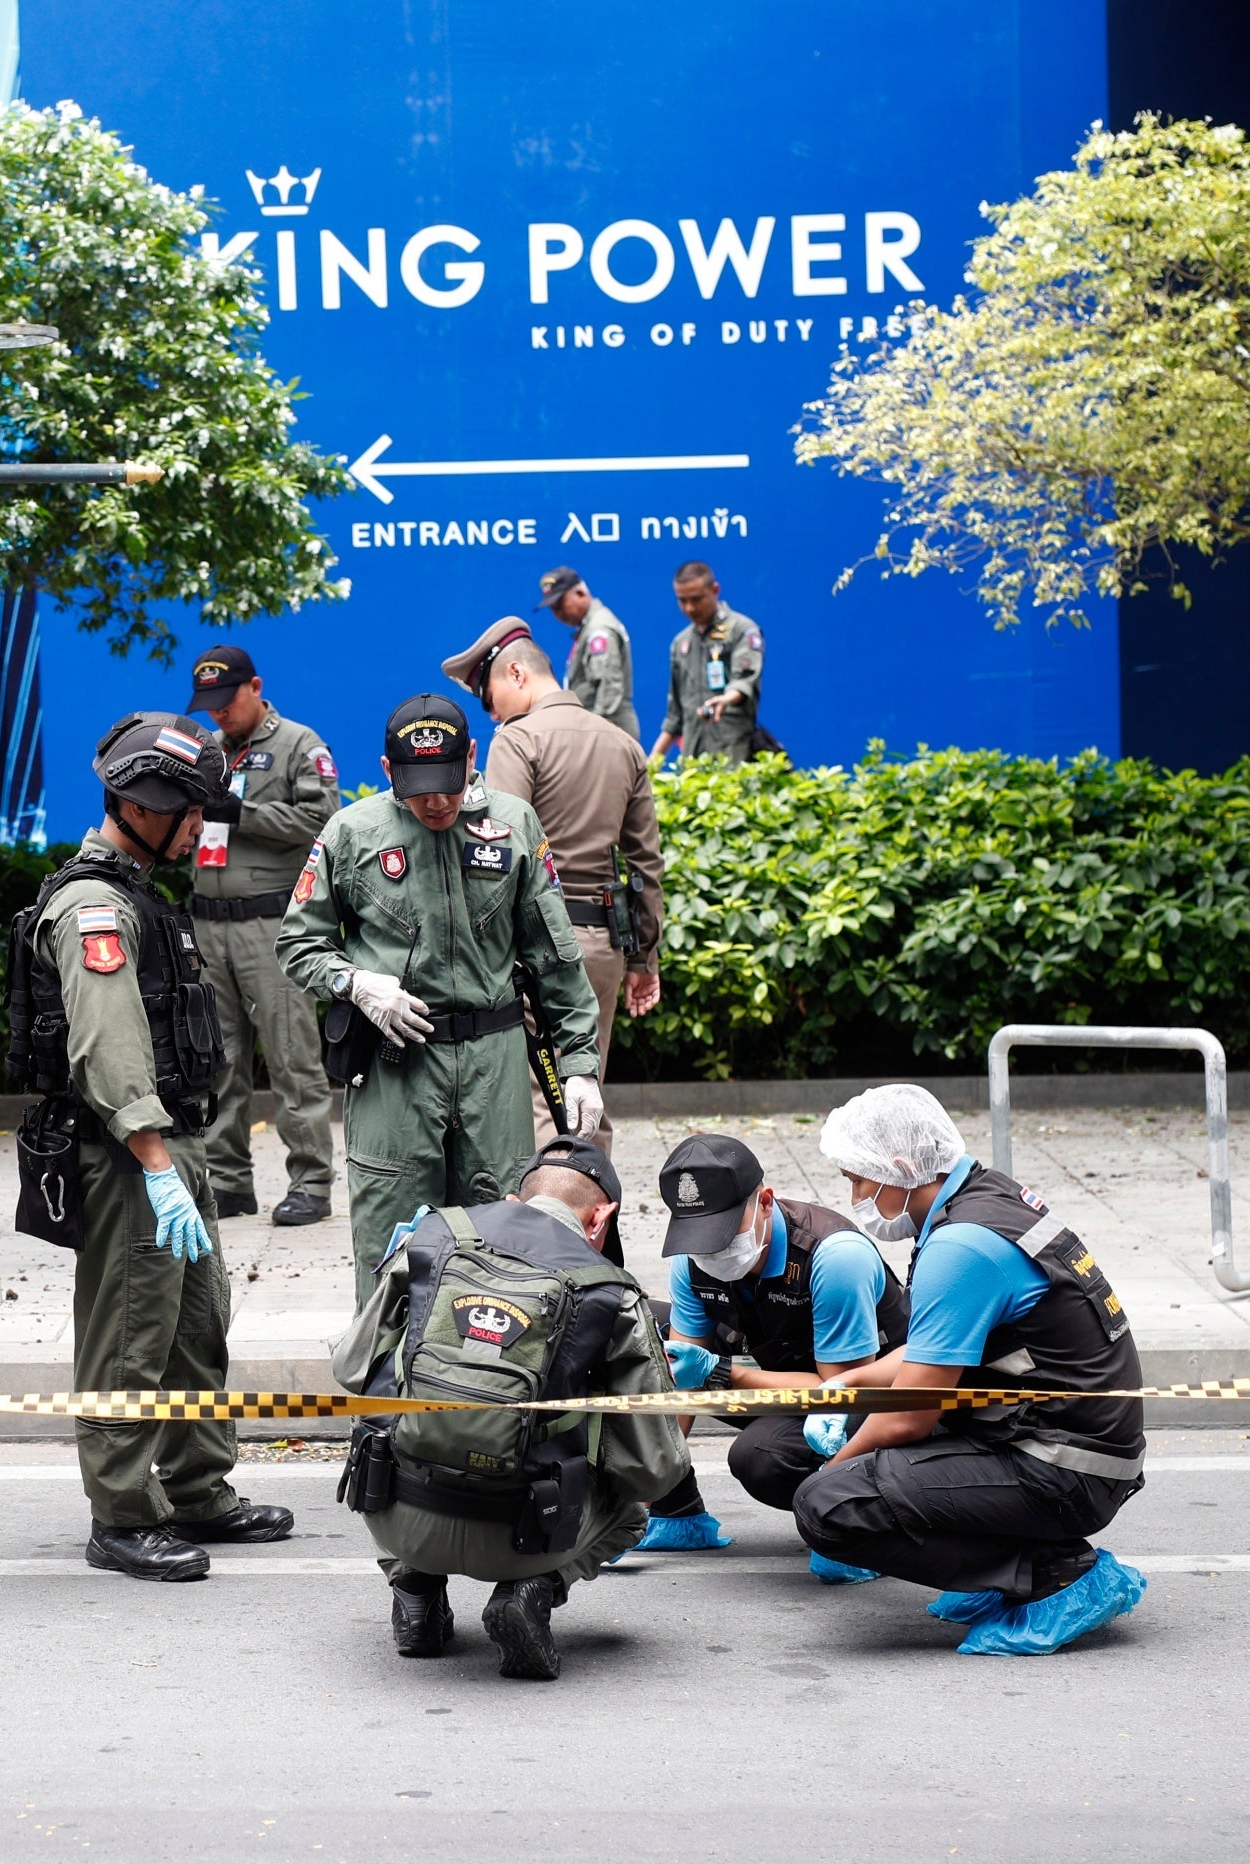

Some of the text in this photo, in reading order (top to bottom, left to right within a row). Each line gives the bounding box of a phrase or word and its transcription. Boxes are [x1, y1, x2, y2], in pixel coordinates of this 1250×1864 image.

[528, 210, 925, 305] POWER
[531, 324, 626, 349] KING
[650, 321, 696, 346] OF
[721, 317, 814, 344] DUTY
[352, 519, 537, 548] ENTRANCE
[560, 512, 620, 543] 入口
[641, 508, 748, 540] ทางเข้า
[414, 747, 442, 755] POLICE
[540, 1048, 563, 1105] GARRETT
[453, 1296, 531, 1329] EXPLOSIVE ORDNANCE DISPOSAL
[468, 1327, 503, 1342] POLICE
